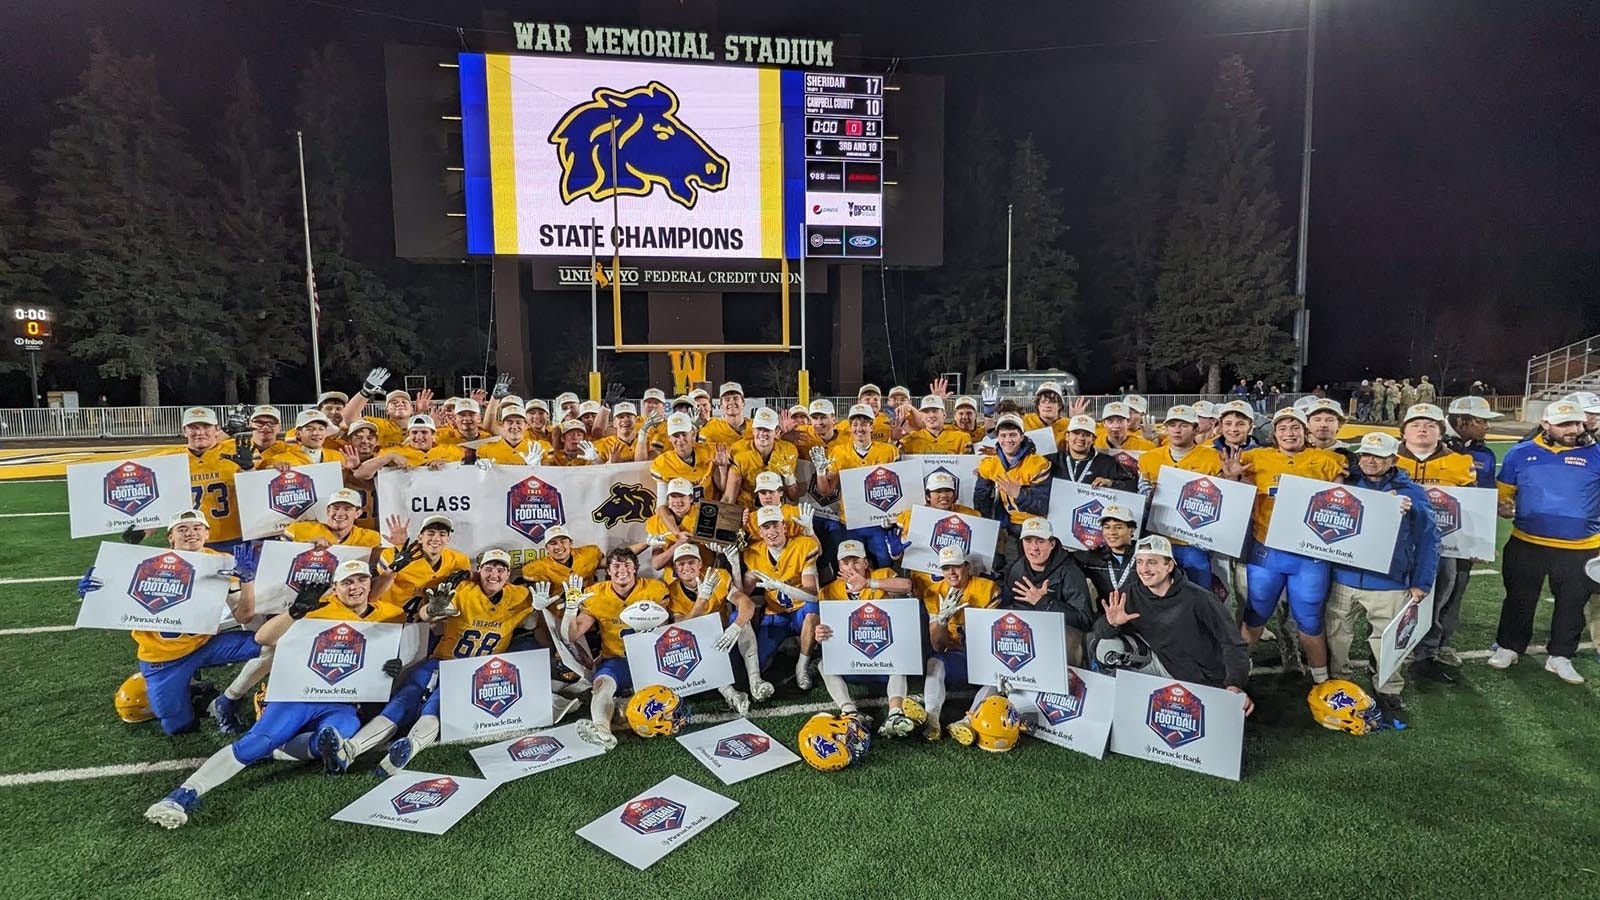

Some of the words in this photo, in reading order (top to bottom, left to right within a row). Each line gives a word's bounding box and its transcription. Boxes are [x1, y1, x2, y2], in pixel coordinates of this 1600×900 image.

[513, 22, 572, 53] WAR
[585, 26, 714, 60] MEMORIAL
[725, 34, 833, 67] STADIUM
[807, 75, 846, 88] SHERIDAN
[866, 78, 879, 94] 17
[807, 96, 833, 109] CAMPBELL
[834, 98, 854, 110] COUNTY
[866, 100, 879, 115] 10
[812, 120, 838, 133] 0:00
[851, 124, 857, 133] 0
[866, 122, 876, 131] 21
[815, 140, 821, 150] 4
[838, 141, 852, 151] 3RD
[853, 142, 867, 151] AND
[868, 143, 877, 152] 10
[810, 172, 825, 180] 988
[539, 223, 604, 248] STATE
[610, 225, 743, 250] CHAMPIONS
[854, 238, 872, 246] Ford
[643, 270, 705, 283] FEDERAL
[708, 271, 757, 284] CREDIT
[15, 308, 47, 320] 0:00
[27, 321, 39, 335] 0
[668, 349, 707, 396] W
[111, 486, 152, 501] FOOTBALL
[190, 482, 230, 518] 73
[275, 492, 310, 505] FOOTBALL
[869, 487, 897, 500] FOOTBALL
[411, 495, 471, 513] CLASS
[1182, 499, 1215, 516] FOOTBALL
[113, 516, 143, 526] Pinnacle
[142, 515, 160, 523] Bank
[515, 508, 557, 520] FOOTBALL
[1312, 511, 1355, 529] FOOTBALL
[1434, 512, 1454, 525] BALL
[1176, 527, 1199, 538] Pinnacle
[1199, 533, 1214, 543] Bank
[1305, 543, 1336, 554] Pinnacle
[1336, 550, 1354, 559] Bank
[138, 580, 185, 595] FOOTBALL
[128, 615, 162, 624] Pinnacle
[472, 619, 502, 629] SHERIDAN
[854, 630, 887, 640] FOOTBALL
[453, 629, 502, 658] 68
[997, 641, 1029, 654] FOOTBALL
[316, 652, 357, 665] FOOTBALL
[662, 650, 695, 667] FOOTBALL
[692, 678, 707, 686] Bank
[1022, 676, 1037, 684] Bank
[340, 687, 358, 695] Bank
[479, 685, 515, 700] FOOTBALL
[1042, 693, 1078, 712] FOOTBALL
[1160, 708, 1180, 717] WYOMING
[479, 719, 507, 729] Pinnacle
[506, 716, 523, 724] Bank
[1154, 712, 1197, 732] FOOTBALL
[1058, 730, 1074, 742] Bank
[518, 744, 556, 758] FOOTBALL
[1152, 747, 1183, 759] Pinnacle
[1183, 754, 1202, 765] Bank
[638, 805, 678, 829] FOOTBALL
